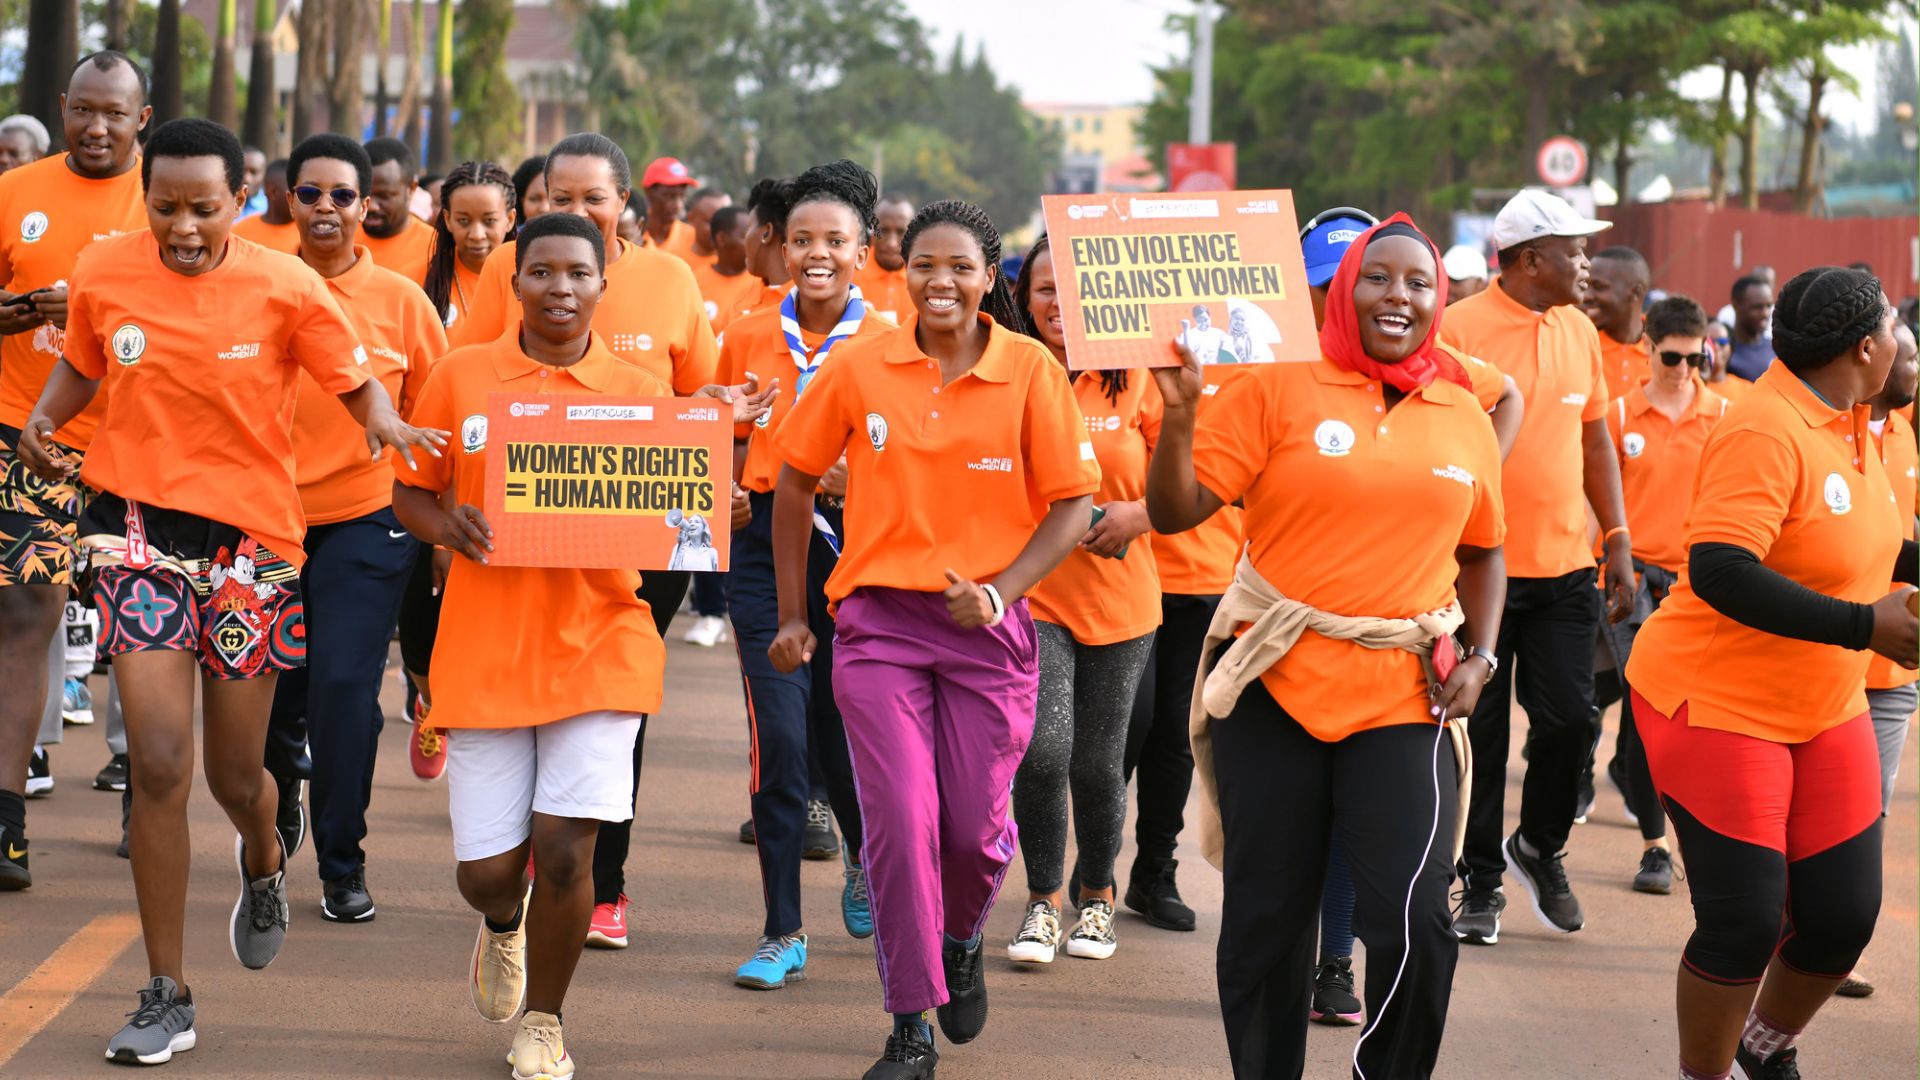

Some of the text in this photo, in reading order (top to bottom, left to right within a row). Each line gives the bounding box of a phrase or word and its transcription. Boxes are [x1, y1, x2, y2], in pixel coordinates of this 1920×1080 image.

[1547, 149, 1576, 171] 40
[1071, 233, 1241, 266] END VIOLENCE
[1080, 265, 1281, 300] AGAINST WOMEN
[1082, 303, 1151, 334] NOW!
[217, 351, 250, 360] WOMEN
[676, 413, 707, 421] WOMEN
[506, 444, 709, 478] WOMEN'S RIGHTS
[967, 462, 1000, 471] WOMEN
[534, 478, 622, 509] HUMAN
[625, 481, 714, 512] RIGHTS
